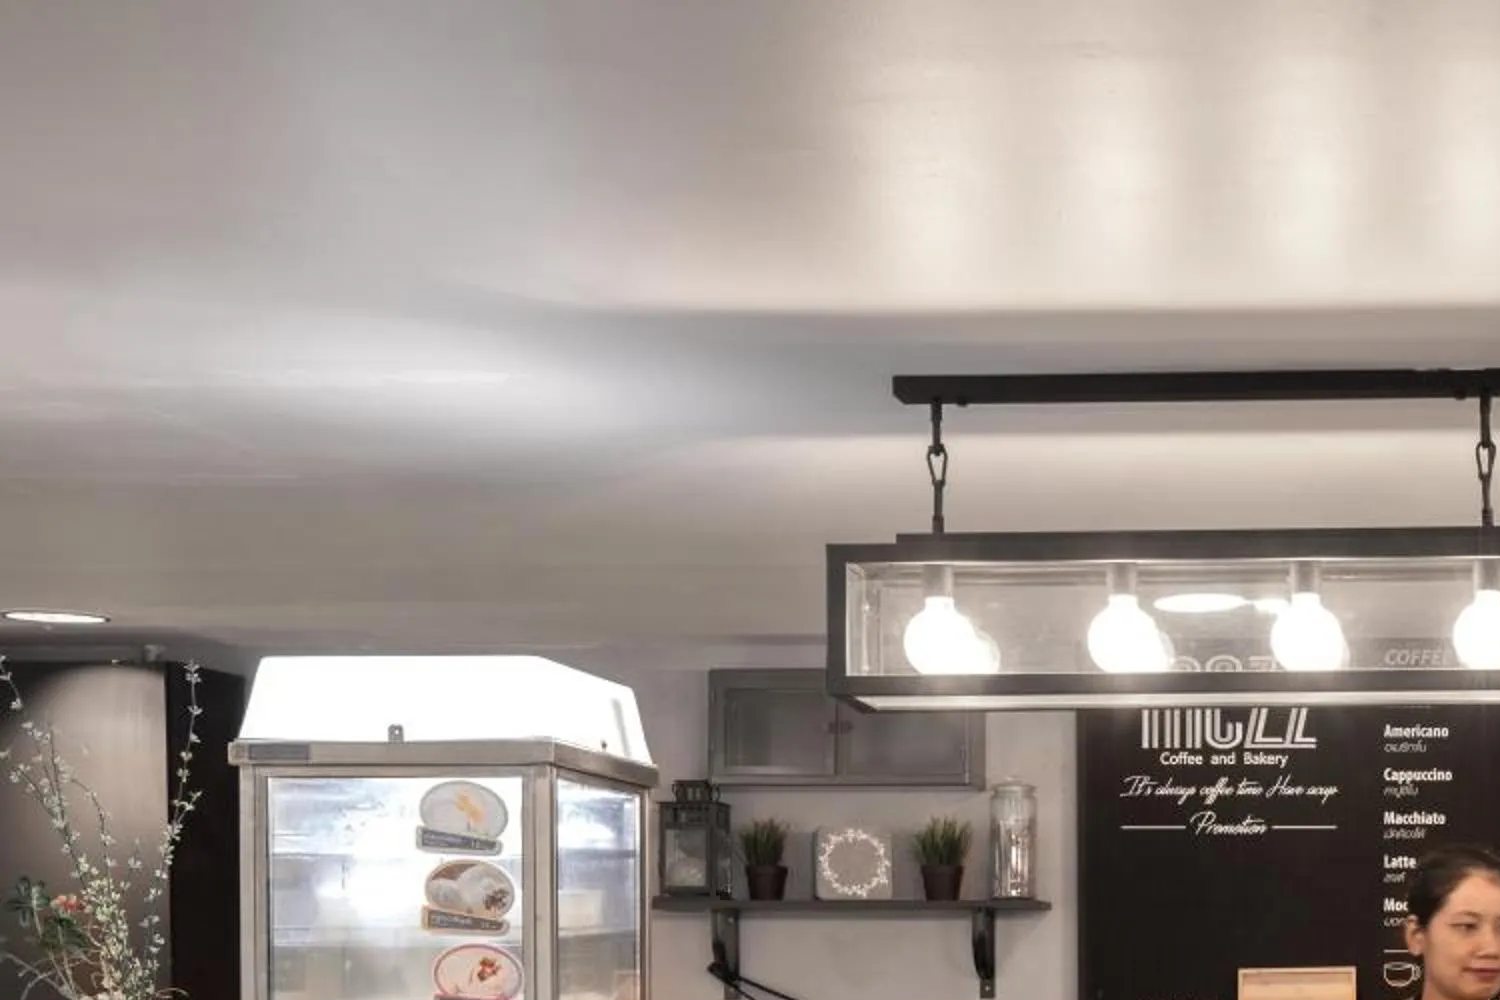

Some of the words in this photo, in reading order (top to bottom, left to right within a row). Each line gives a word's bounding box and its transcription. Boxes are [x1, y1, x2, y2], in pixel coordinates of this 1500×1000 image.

[1384, 724, 1448, 738] Americano
[1160, 752, 1203, 765] Coffee
[1211, 752, 1236, 764] and
[1244, 752, 1288, 768] Bakery
[1384, 768, 1452, 786] Cappuccino
[1190, 811, 1268, 836] Promotion
[1384, 811, 1445, 824] Macchiato
[1384, 856, 1416, 868] Latte
[1384, 899, 1408, 912] Moc
